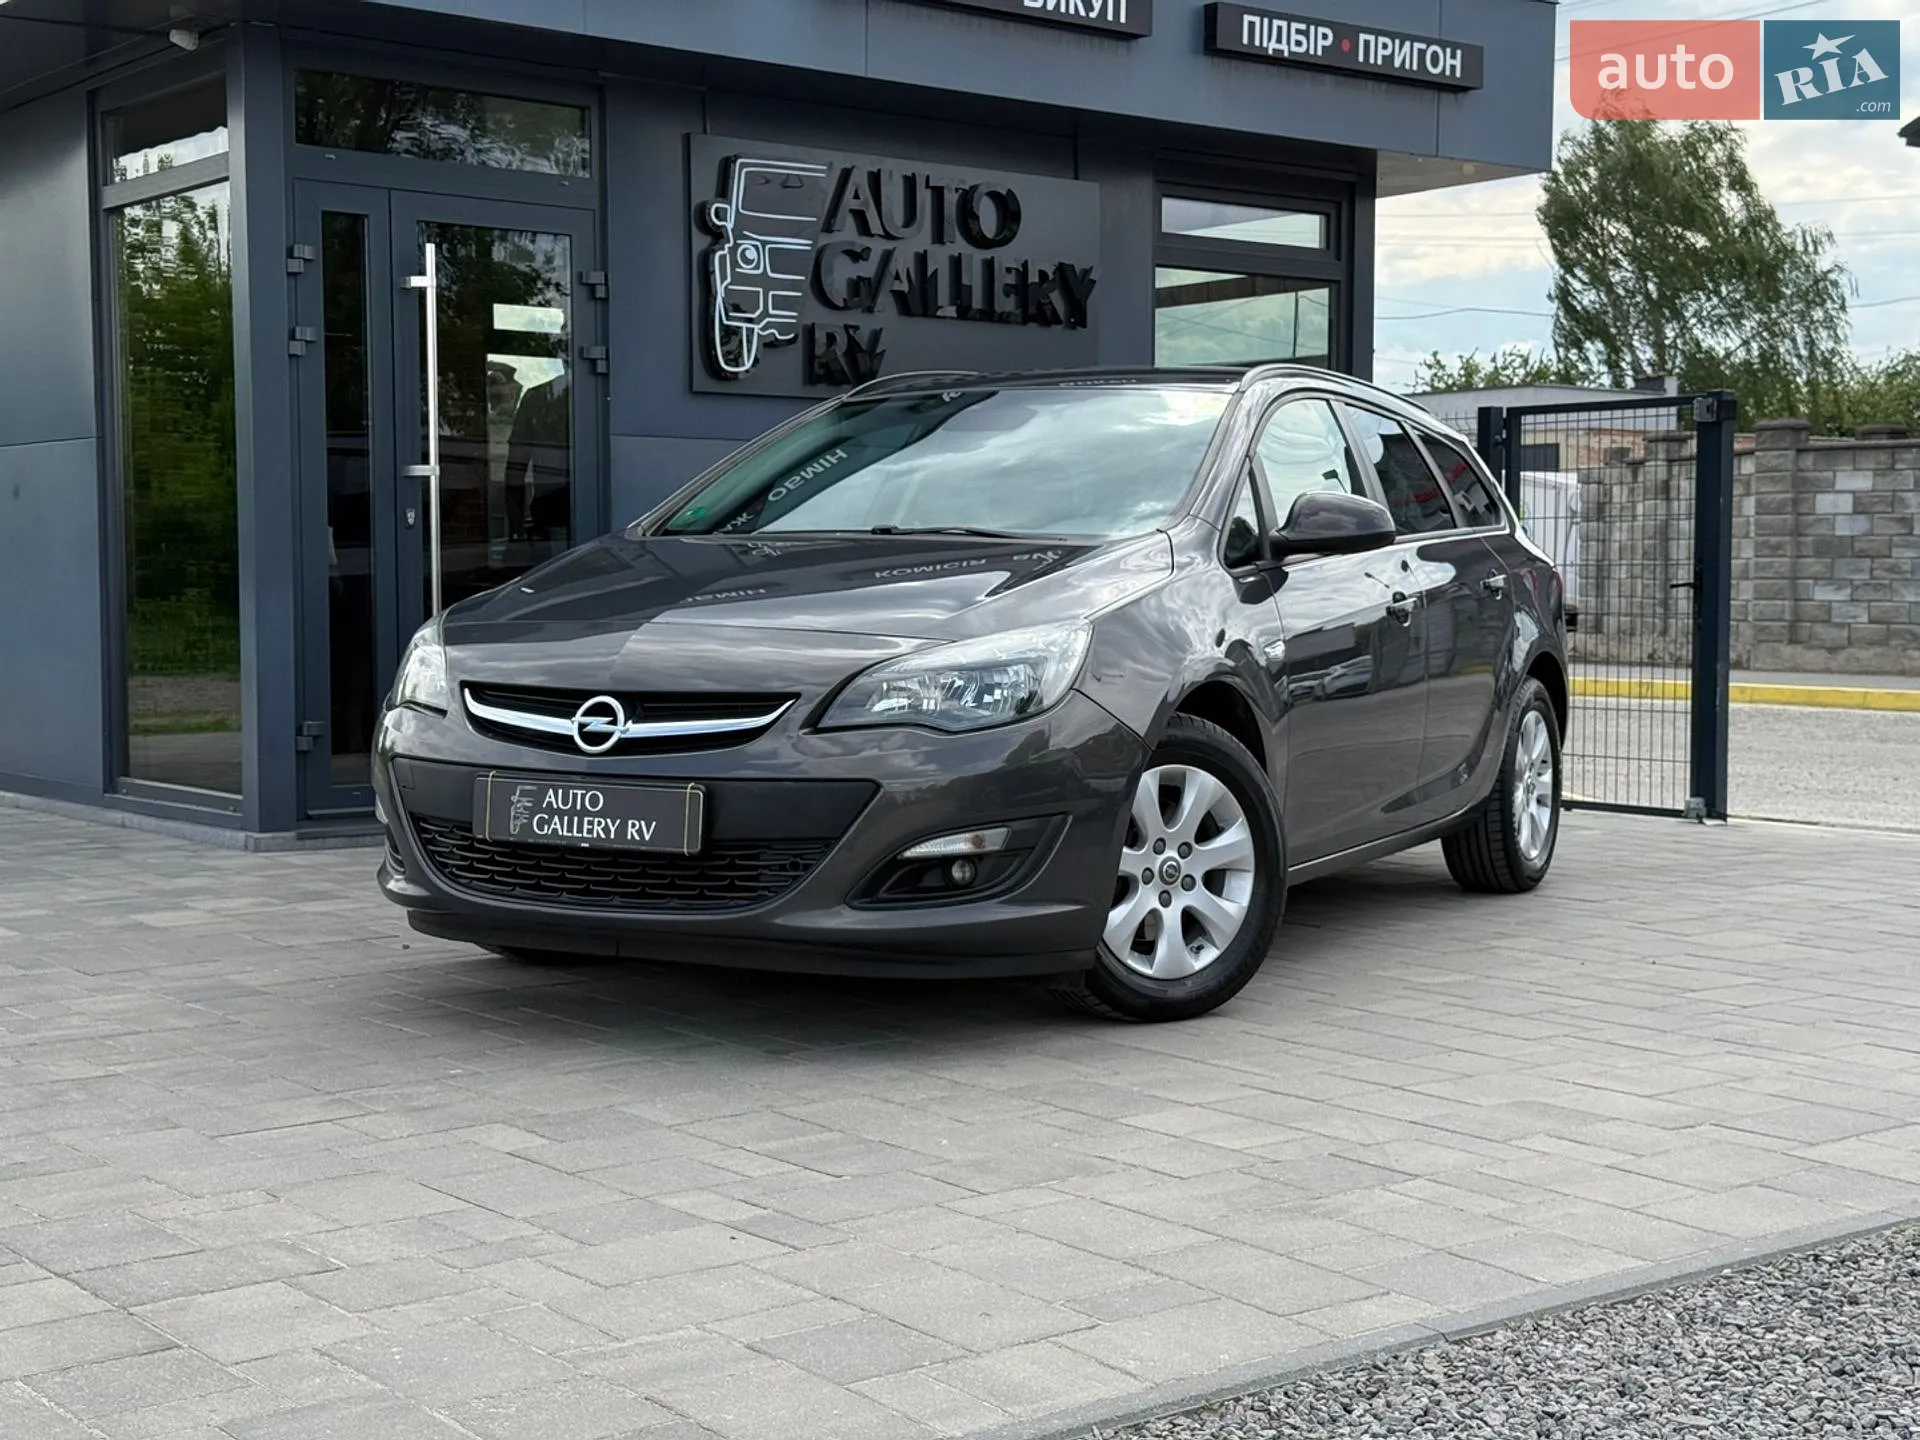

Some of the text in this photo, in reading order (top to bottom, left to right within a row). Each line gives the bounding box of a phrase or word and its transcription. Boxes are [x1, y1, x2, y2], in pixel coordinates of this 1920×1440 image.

[1242, 14, 1462, 78] ПІДБІР ПРИГОН
[821, 164, 1022, 250] AUTO
[810, 240, 1097, 330] GALLERY
[802, 322, 887, 388] RV
[532, 813, 657, 841] GALLERY RV
[542, 788, 604, 812] AUTO
